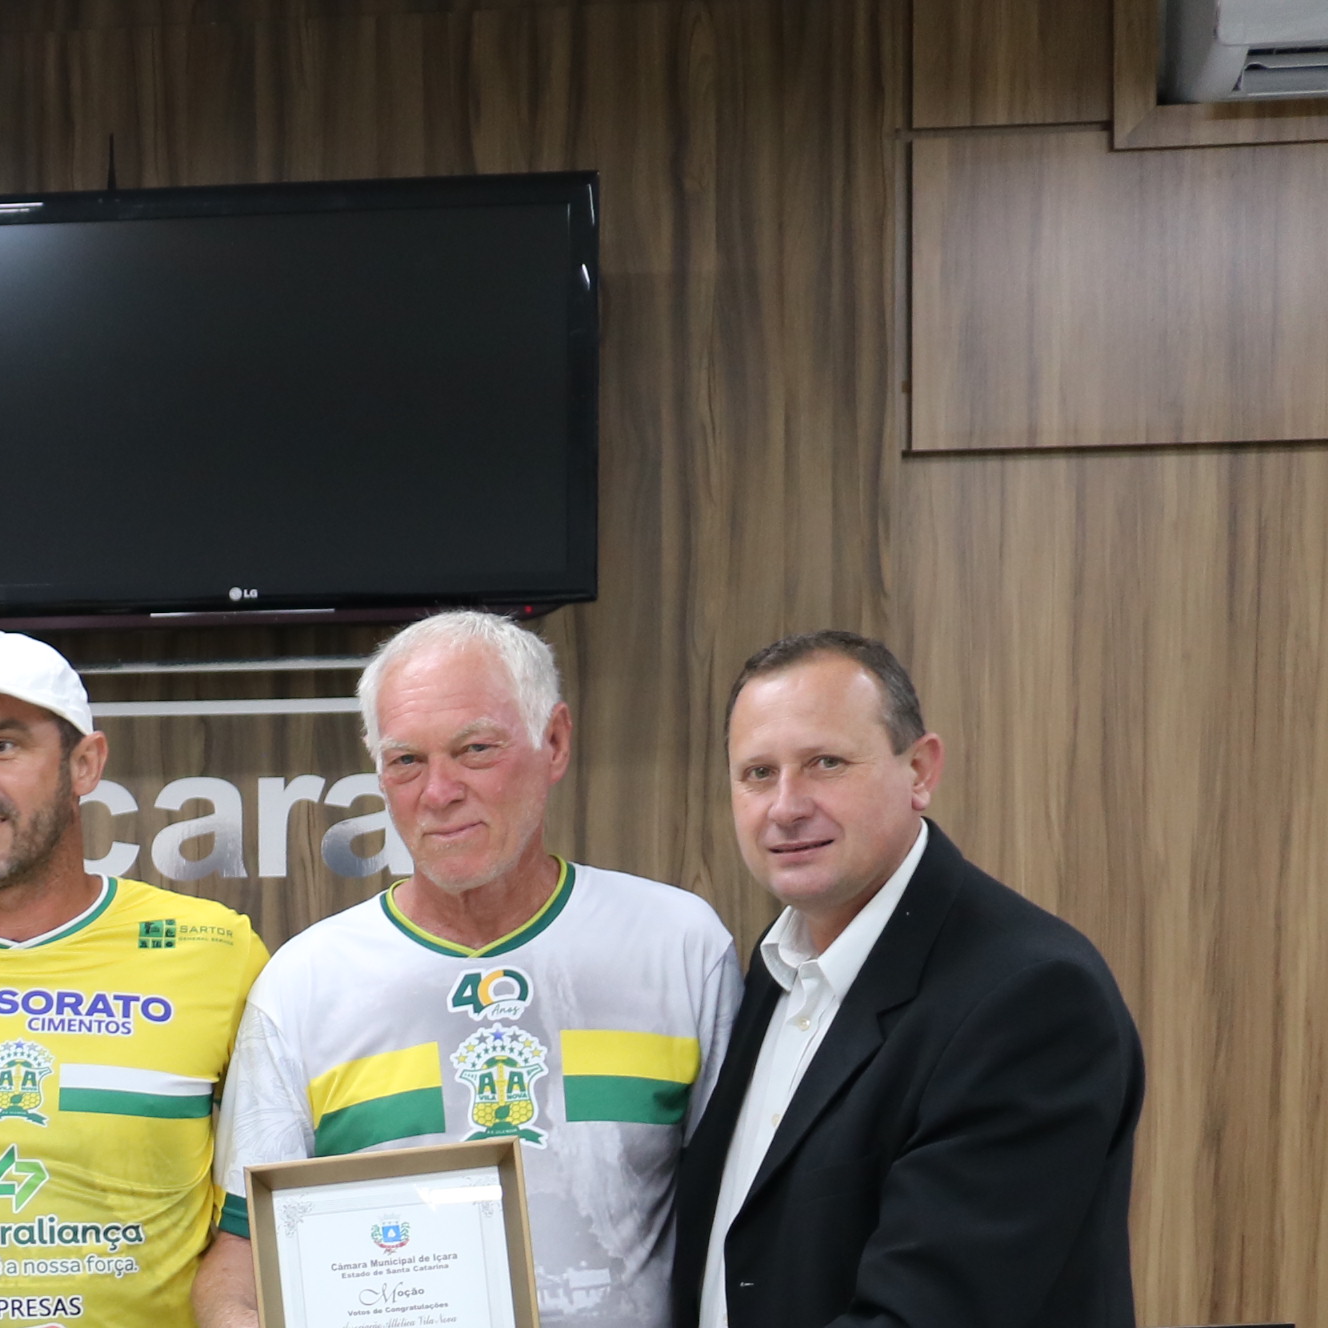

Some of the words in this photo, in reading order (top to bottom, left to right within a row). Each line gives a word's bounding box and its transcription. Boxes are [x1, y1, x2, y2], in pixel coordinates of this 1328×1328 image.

[244, 589, 258, 598] LG
[180, 925, 233, 937] SARTOR
[452, 969, 529, 1014] 40
[490, 1003, 520, 1018] Anos
[28, 1018, 132, 1035] CIMENTOS
[4, 1262, 18, 1275] a
[24, 1258, 81, 1275] nossa
[331, 1262, 367, 1271] Câmara
[370, 1256, 415, 1267] Municipal
[433, 1253, 458, 1262] Içara
[413, 1263, 449, 1272] Catarina
